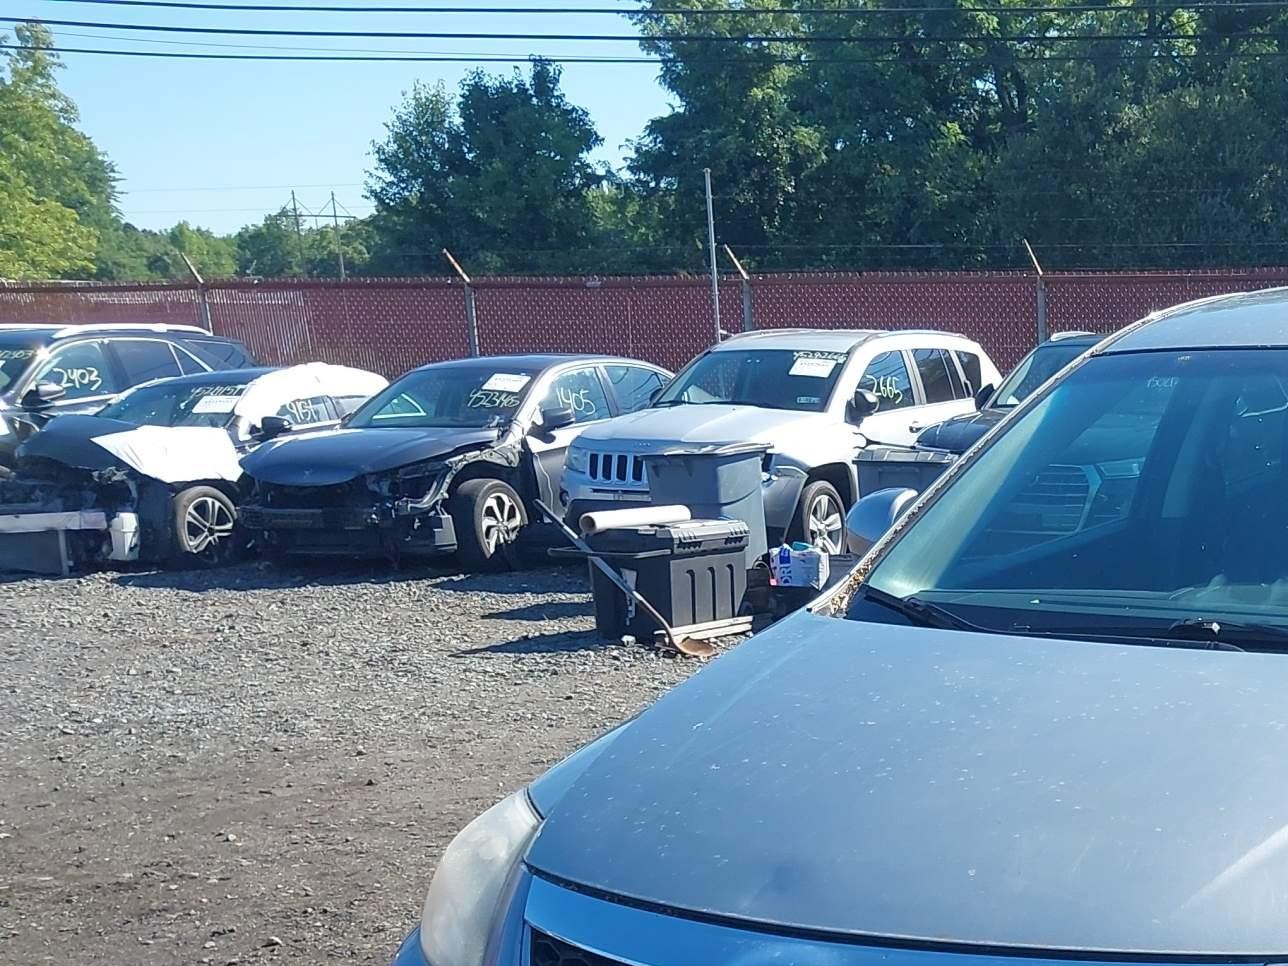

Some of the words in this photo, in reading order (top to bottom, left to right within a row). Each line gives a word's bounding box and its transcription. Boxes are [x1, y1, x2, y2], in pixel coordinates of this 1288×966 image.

[52, 367, 102, 391] 2403
[865, 374, 903, 404] 2665
[556, 387, 595, 415] 1405
